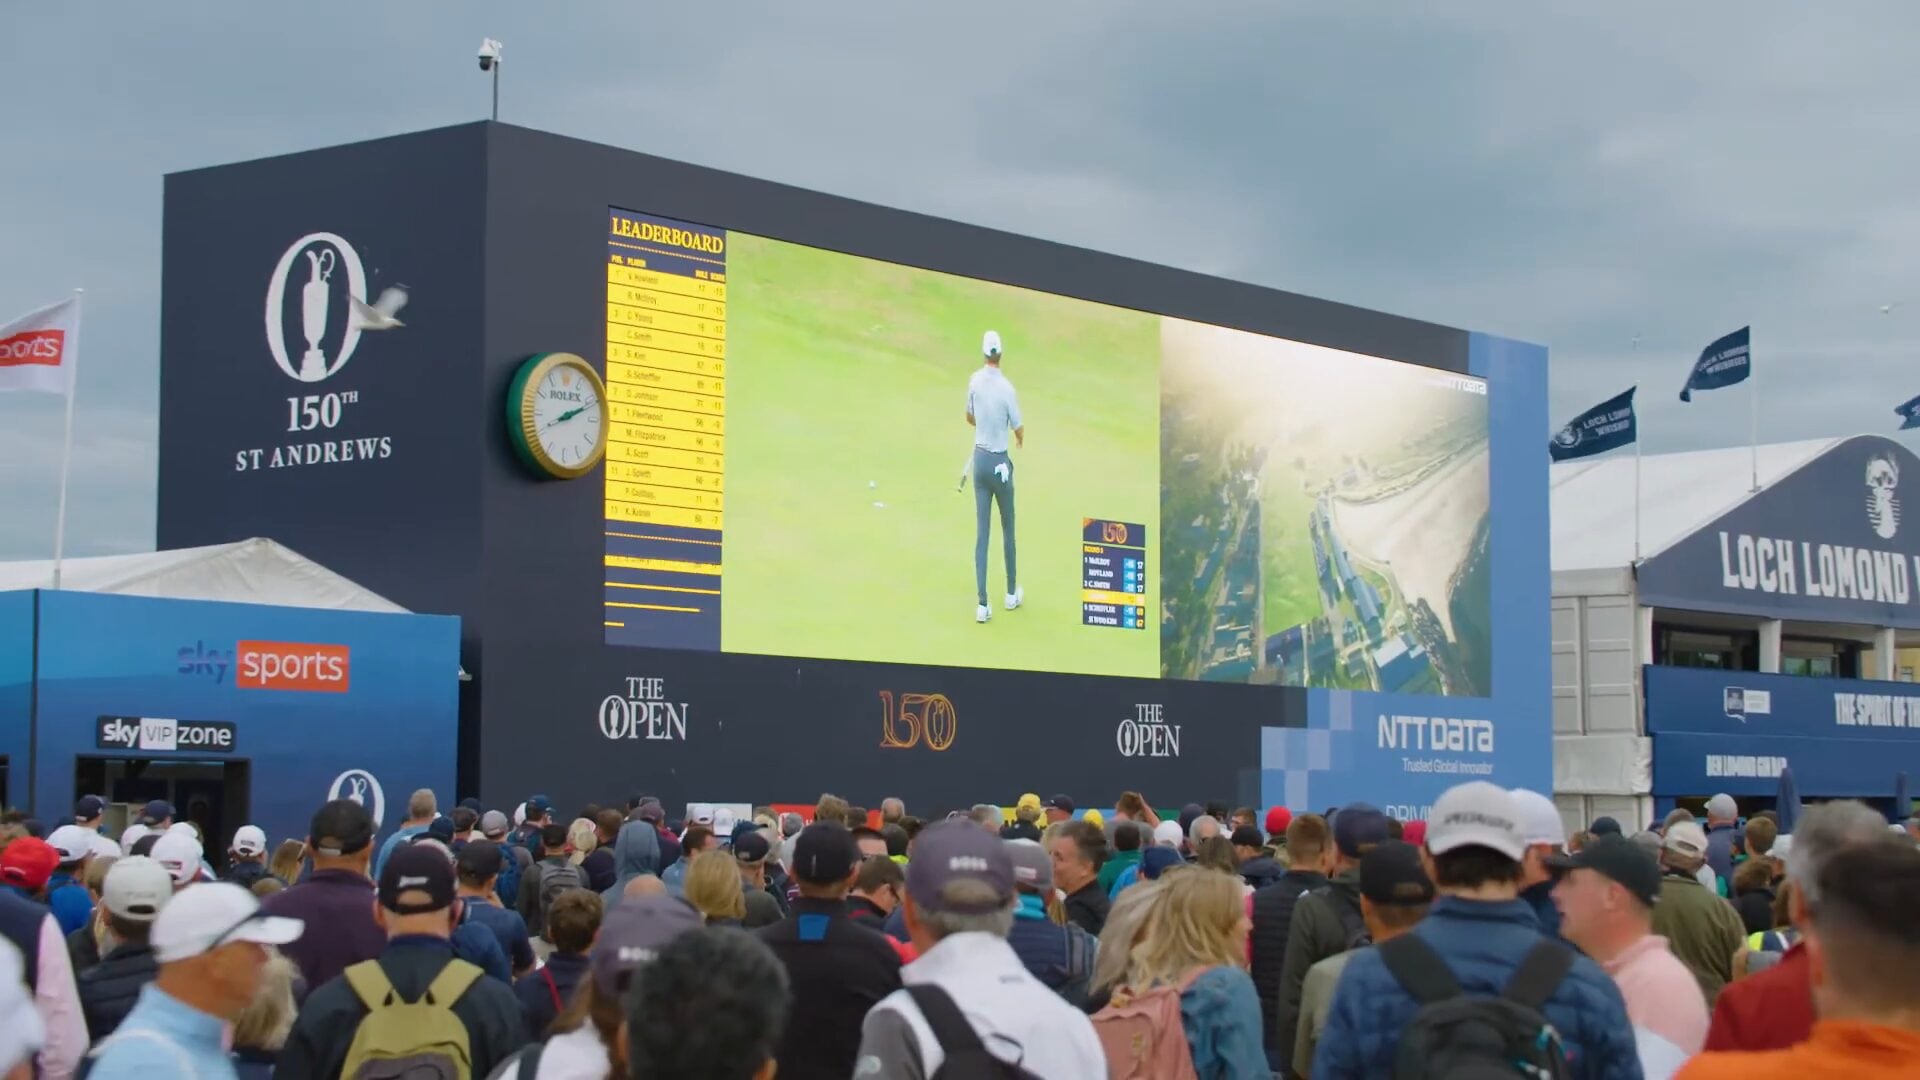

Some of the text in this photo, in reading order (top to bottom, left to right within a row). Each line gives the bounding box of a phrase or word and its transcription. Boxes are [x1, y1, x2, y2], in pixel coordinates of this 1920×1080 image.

[612, 216, 724, 254] LEADERBOARD
[550, 390, 581, 402] ROLEX
[235, 436, 392, 471] ST ANDREWS
[1719, 531, 1798, 595] LOCH
[1801, 541, 1909, 605] LOMOND
[178, 639, 343, 685] sky sports
[625, 676, 664, 700] THE
[599, 694, 689, 741] OPEN
[879, 690, 957, 751] 150
[1135, 703, 1164, 723] THE
[103, 718, 232, 748] sky VIP zone
[1117, 719, 1181, 757] OPEN
[1378, 714, 1428, 750] NTT
[1402, 757, 1432, 773] Trusted
[1385, 803, 1431, 821] DRIVI
